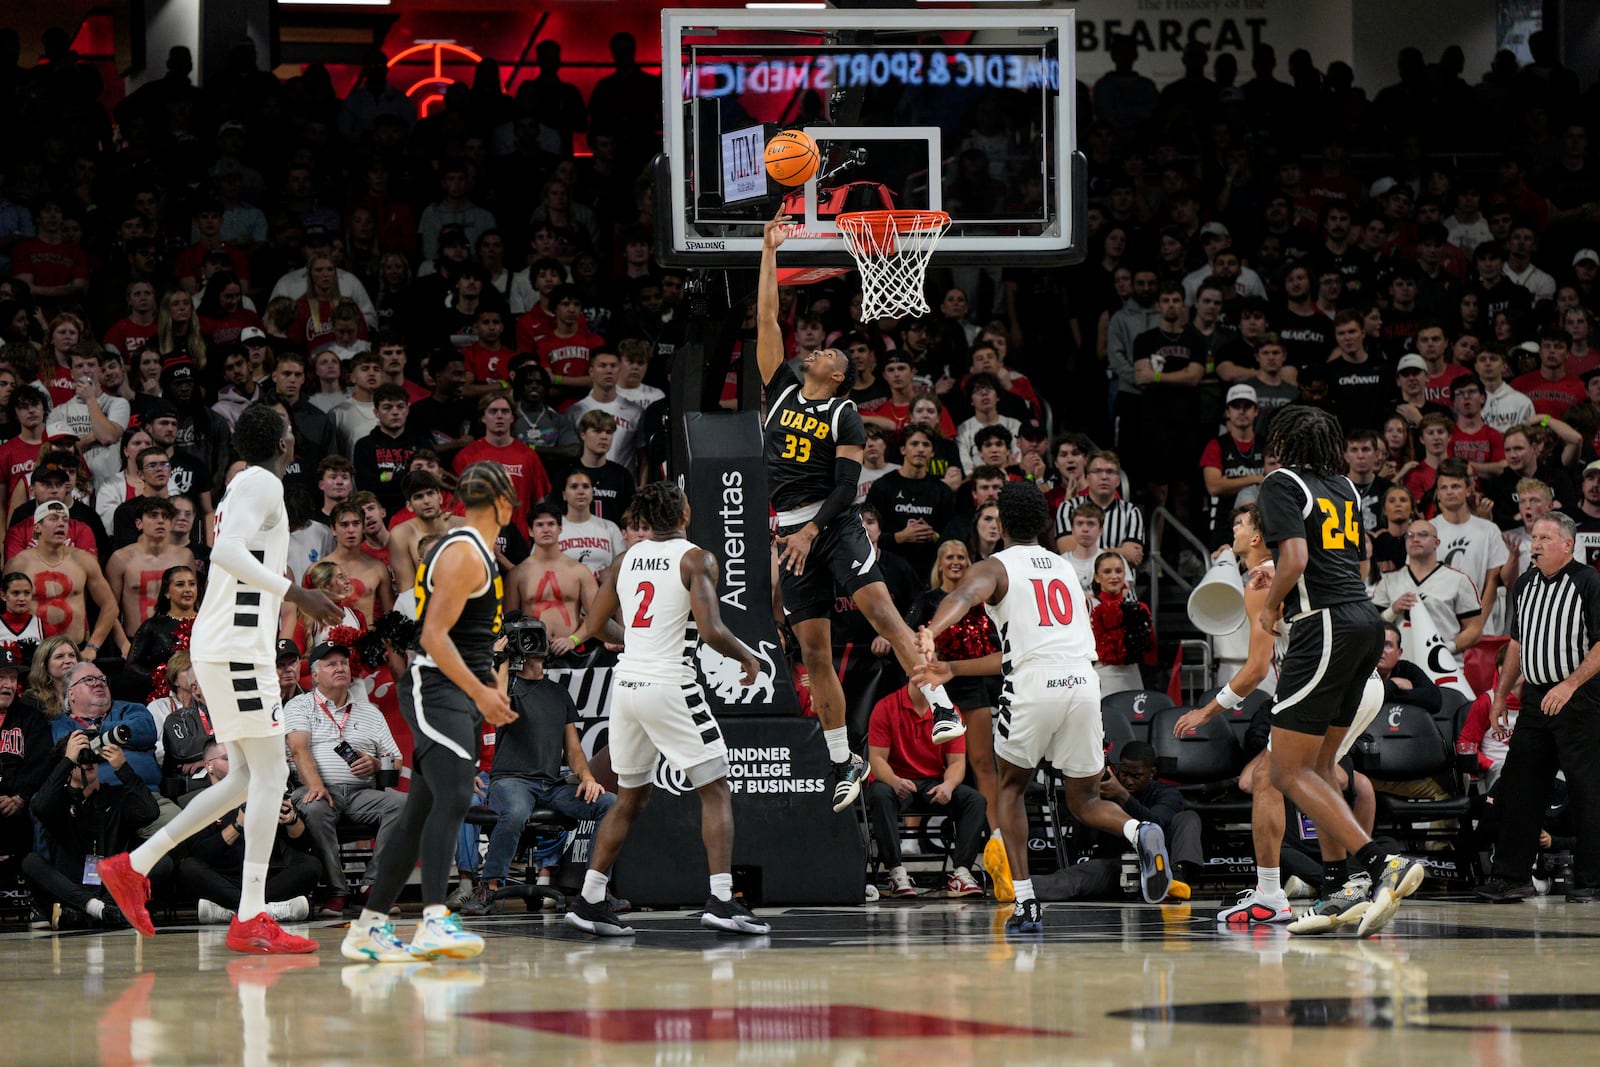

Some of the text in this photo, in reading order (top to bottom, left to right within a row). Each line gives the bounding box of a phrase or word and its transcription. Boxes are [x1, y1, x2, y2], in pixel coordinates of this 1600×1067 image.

[685, 241, 725, 251] SPALDING
[779, 408, 831, 440] UAPB
[781, 433, 812, 463] 33
[719, 470, 747, 611] Ameritas
[1316, 497, 1361, 553] 24
[631, 558, 670, 571] JAMES
[1030, 557, 1052, 569] REED
[33, 570, 74, 635] B
[532, 570, 572, 627] A
[631, 580, 656, 628] 2
[1028, 578, 1074, 627] 10
[1046, 674, 1087, 689] BEARCATS
[727, 747, 791, 762] INDNER
[747, 779, 825, 793] BUSINESS
